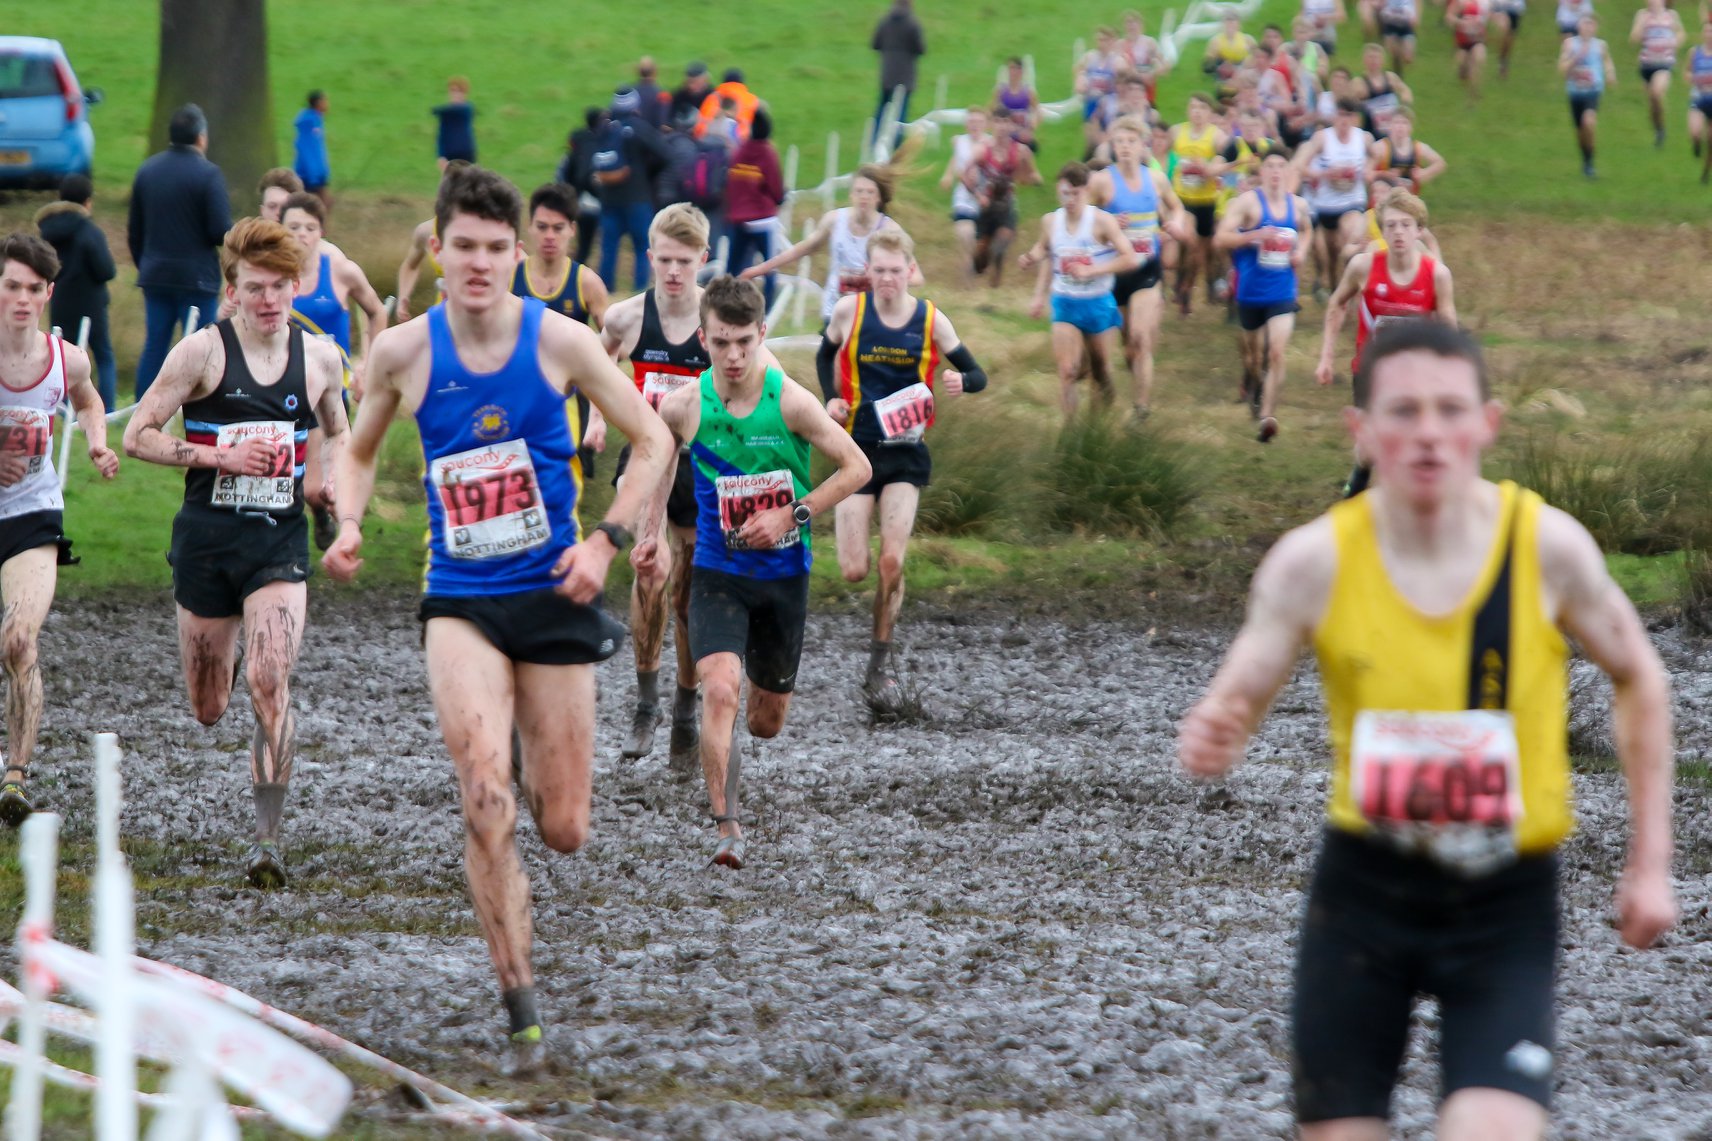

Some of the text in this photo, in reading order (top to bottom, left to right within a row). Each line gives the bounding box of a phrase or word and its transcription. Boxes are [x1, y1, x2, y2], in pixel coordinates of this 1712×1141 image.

[860, 354, 914, 364] HEATHSID
[873, 345, 908, 356] LONDON
[886, 398, 933, 433] 1816
[227, 425, 277, 436] saucony
[440, 449, 500, 473] saucony
[724, 476, 772, 491] saucony
[445, 468, 537, 526] 1973
[455, 528, 548, 557] NOTTINGHAM
[1377, 757, 1508, 827] 1609
